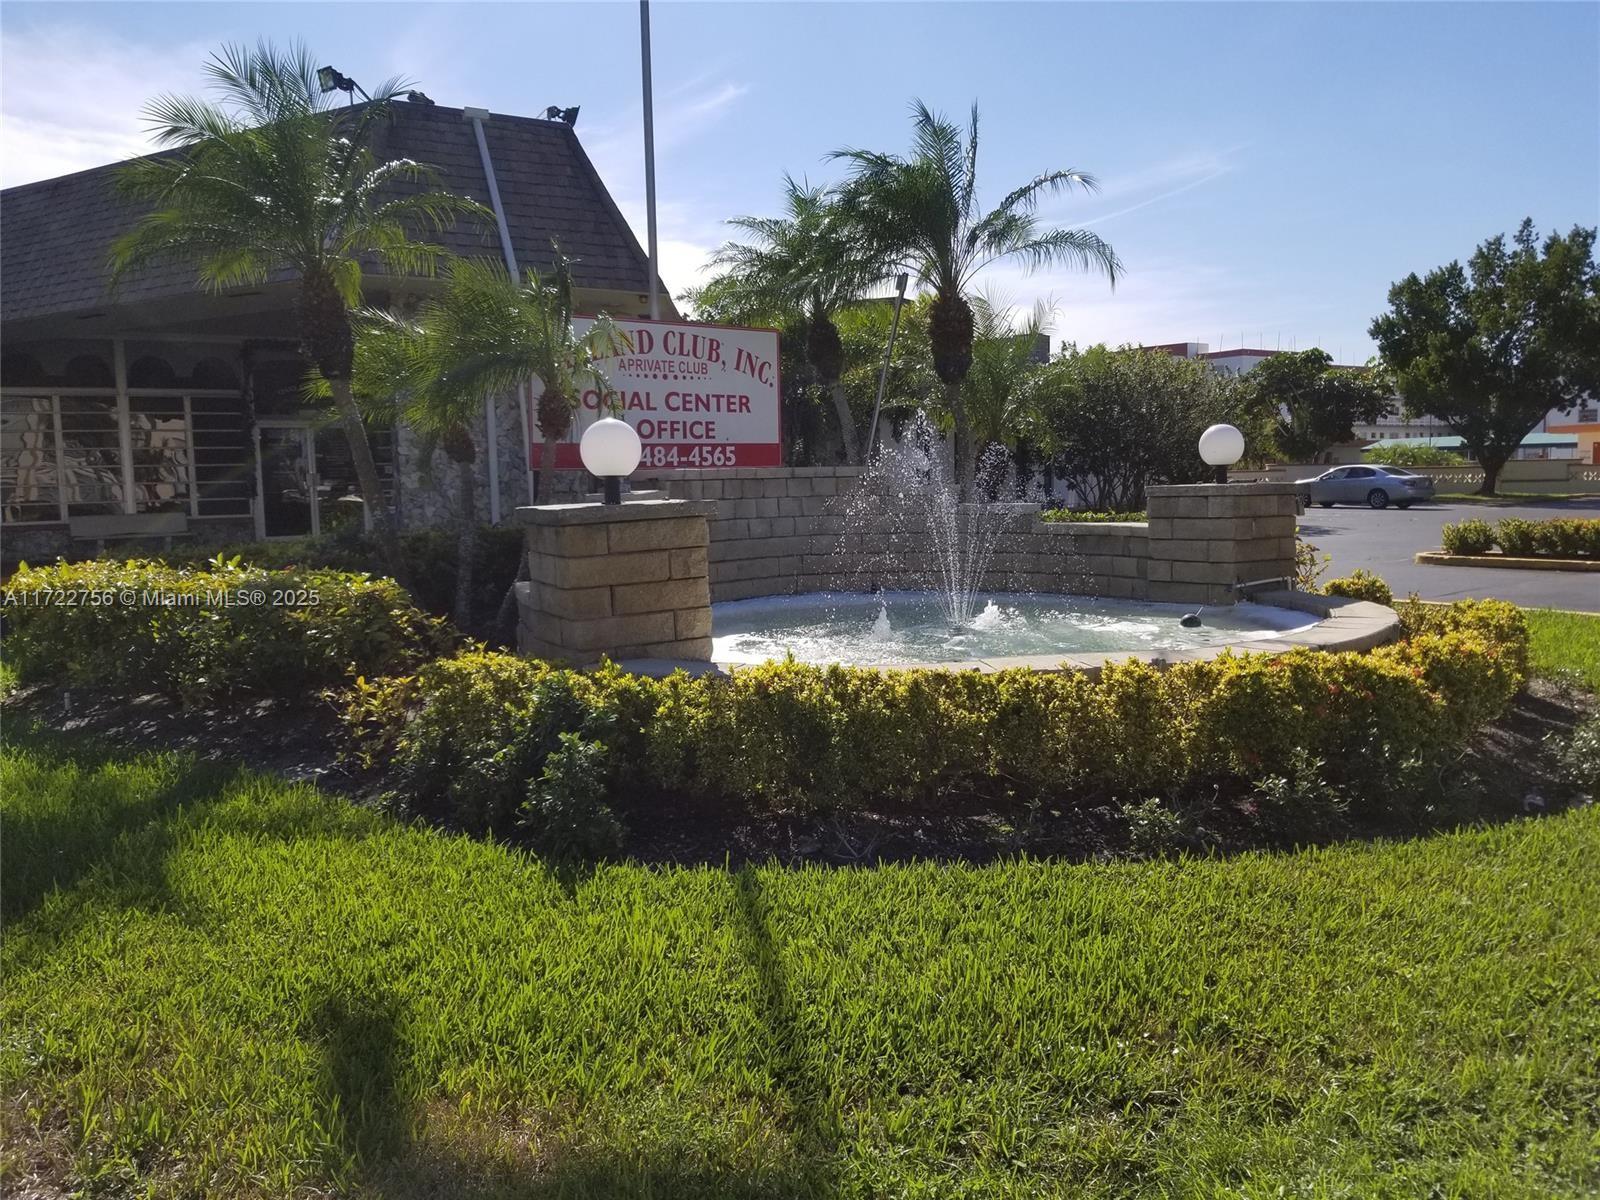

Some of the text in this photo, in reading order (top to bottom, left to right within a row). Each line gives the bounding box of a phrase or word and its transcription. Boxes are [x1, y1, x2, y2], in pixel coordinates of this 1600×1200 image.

[574, 329, 775, 388] LAND CLUB, INC.
[679, 361, 709, 375] CLUB
[578, 390, 751, 413] OCIAL CENTER
[637, 419, 716, 439] OFFICE
